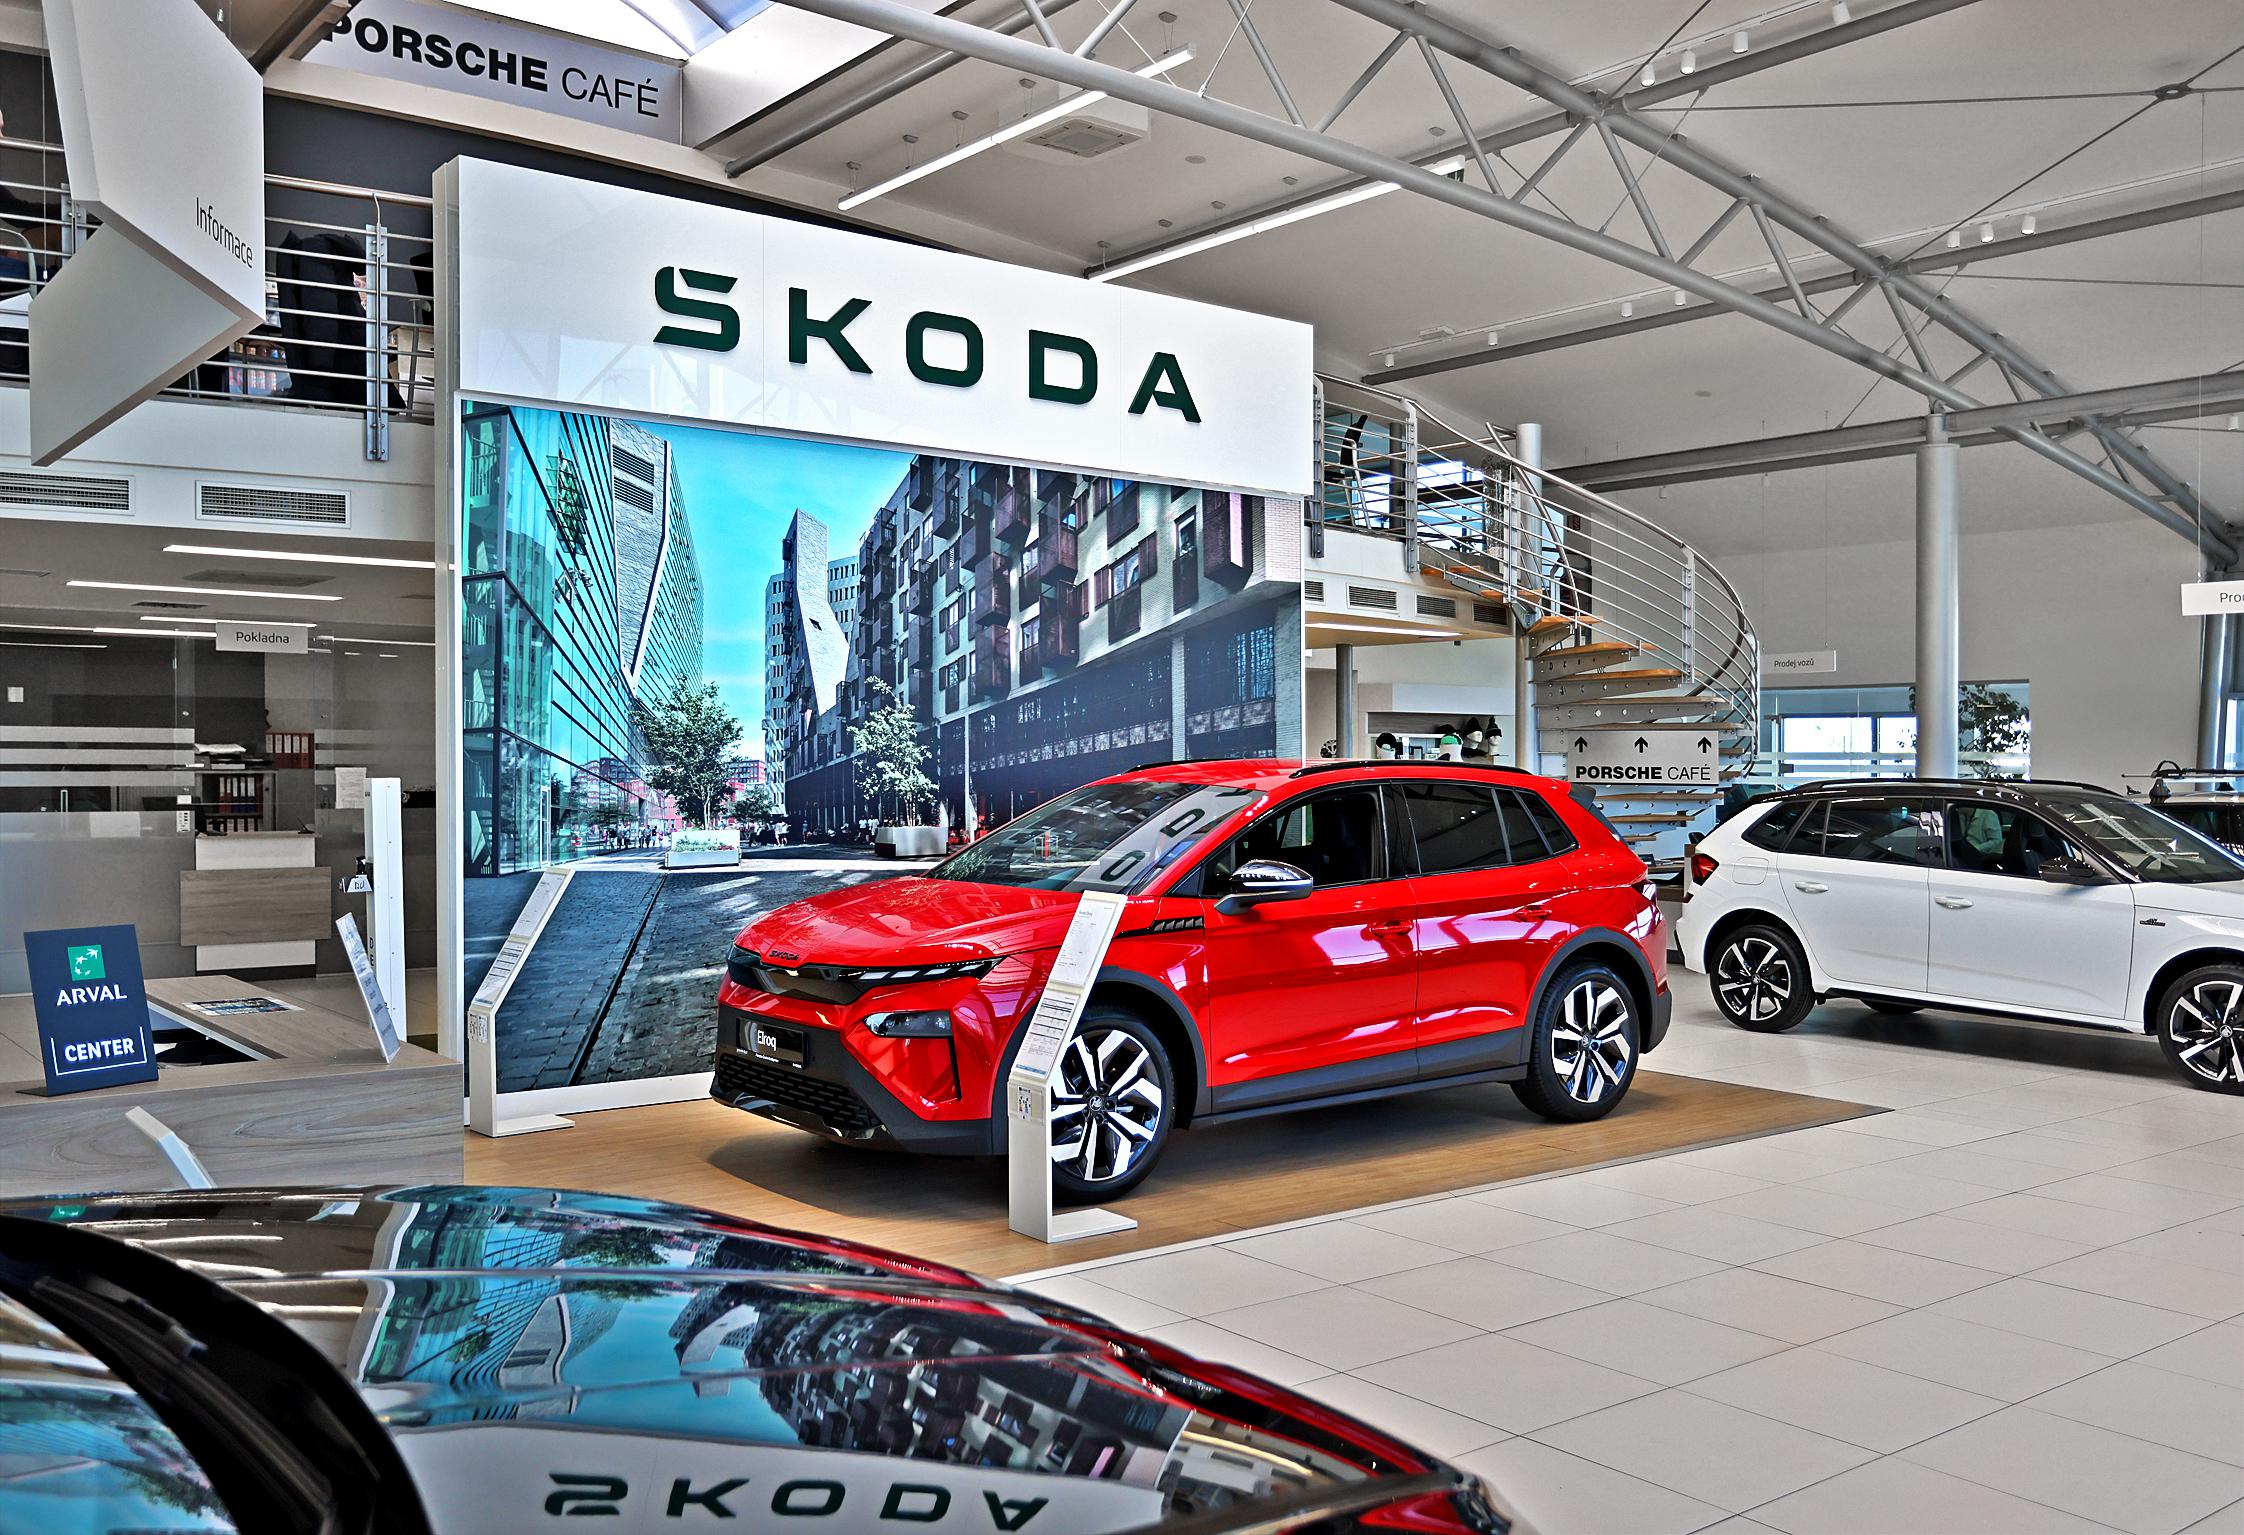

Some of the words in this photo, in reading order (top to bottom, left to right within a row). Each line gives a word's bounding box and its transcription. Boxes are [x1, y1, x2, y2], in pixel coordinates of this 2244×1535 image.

[561, 68, 659, 118] CAFÉ
[196, 196, 253, 269] Informace
[2219, 592, 2244, 603] Pro
[236, 631, 290, 644] Pokladna
[1774, 658, 1796, 668] Prodej
[1797, 657, 1815, 667] vozů
[1575, 765, 1662, 780] PORSCHE
[1667, 763, 1711, 780] CAFÉ
[56, 984, 128, 1006] ARVAL
[64, 1037, 135, 1062] CENTER
[757, 1029, 777, 1052] Elroq
